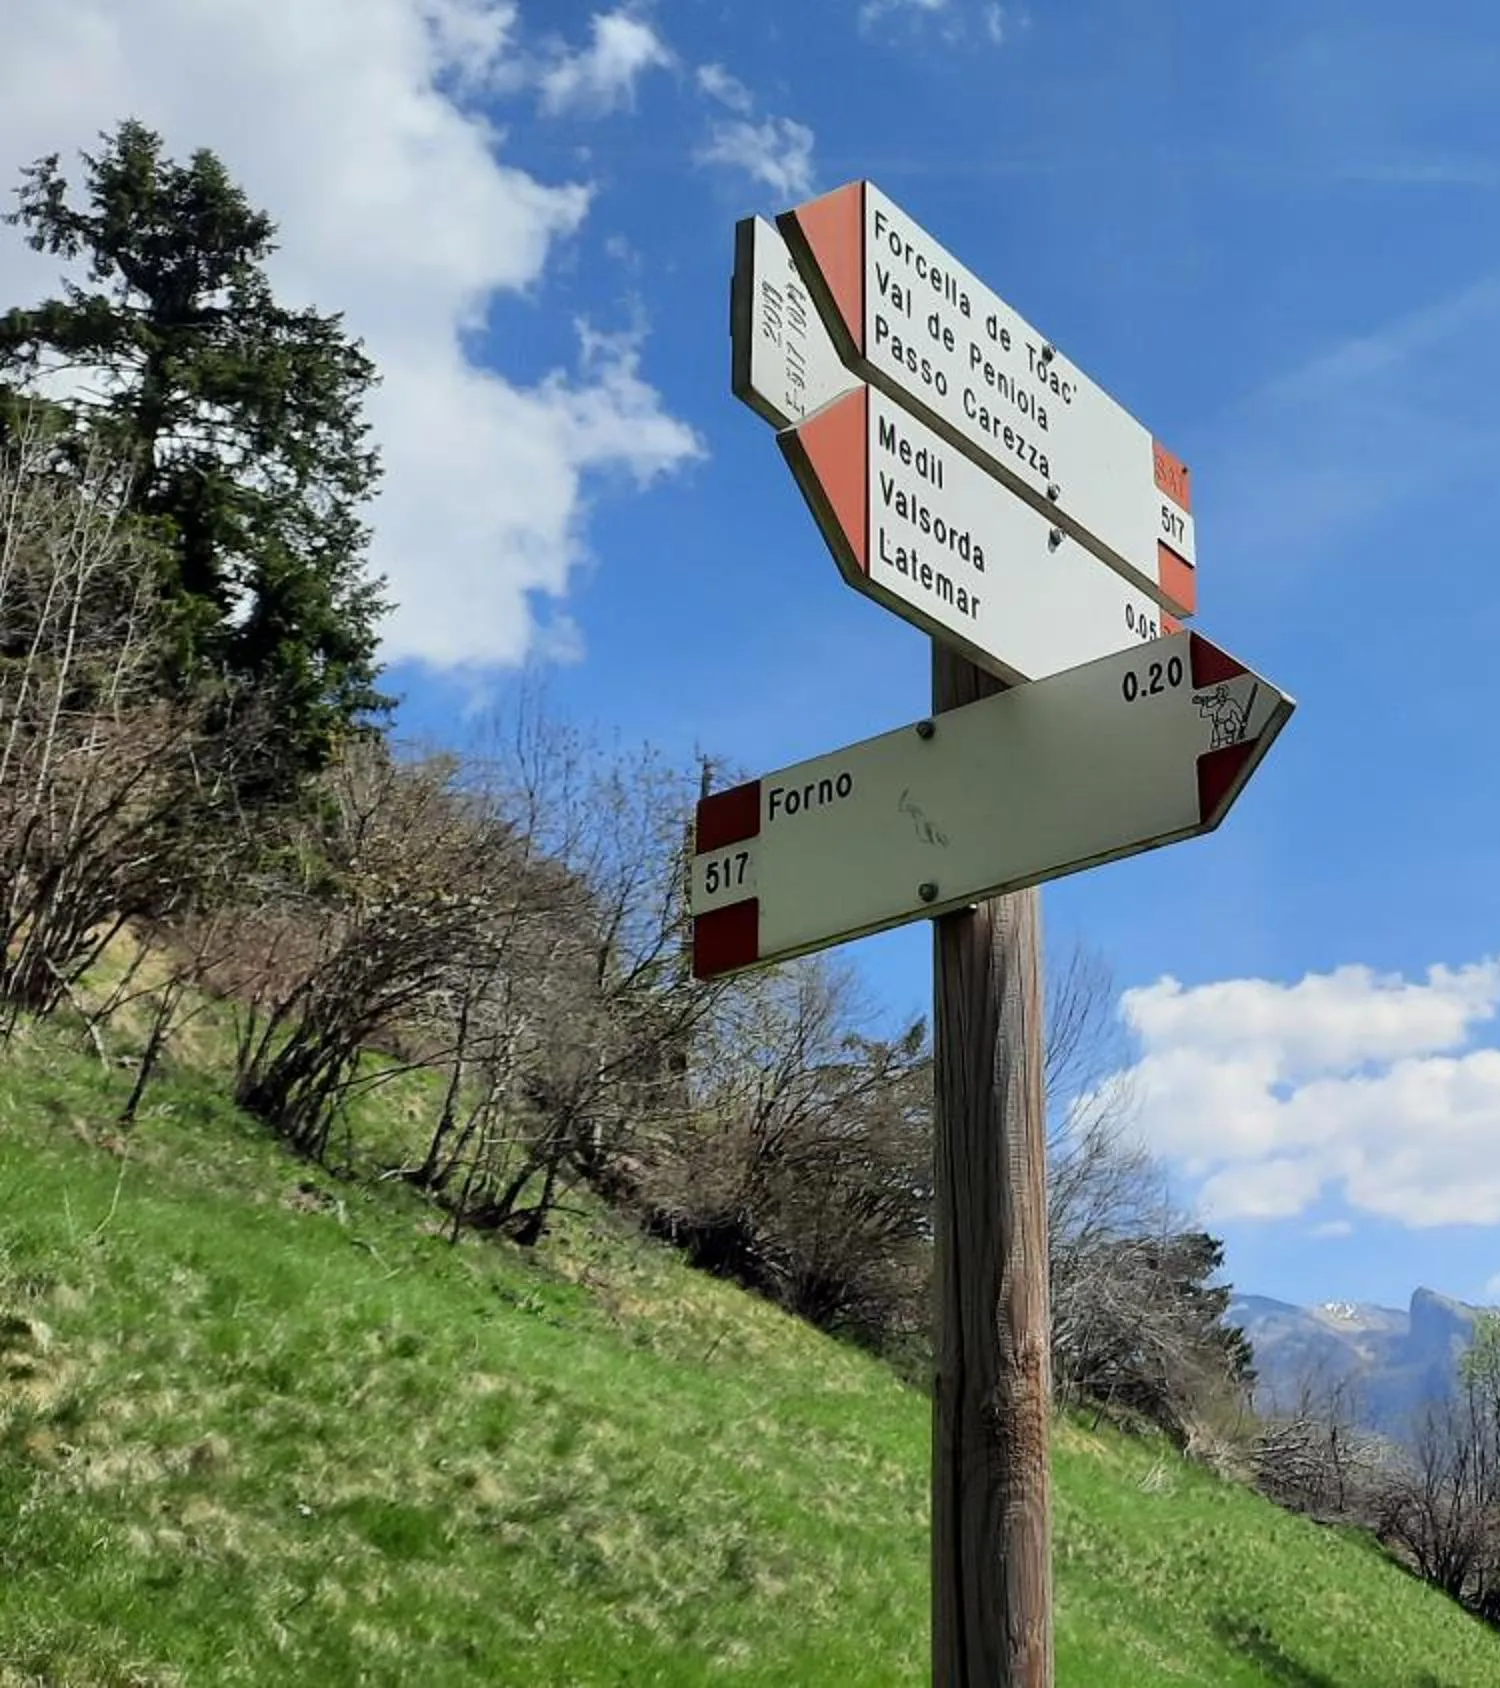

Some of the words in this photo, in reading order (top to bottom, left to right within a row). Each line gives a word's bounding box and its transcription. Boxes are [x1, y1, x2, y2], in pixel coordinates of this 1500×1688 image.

[874, 210, 972, 319] Forcella
[985, 315, 1012, 353] de
[875, 262, 912, 319] Val
[927, 312, 955, 353] de
[969, 342, 1049, 432] Peniola
[874, 315, 948, 397] Passo
[962, 387, 1051, 481] Carezza
[878, 414, 943, 490] Medil
[879, 470, 986, 573] Valsorda
[1161, 504, 1185, 545] 517
[879, 526, 981, 620] Latemar
[1125, 603, 1157, 641] 0.05
[1121, 655, 1183, 702] 0.20
[768, 772, 853, 822] Forno
[705, 851, 749, 894] 517
